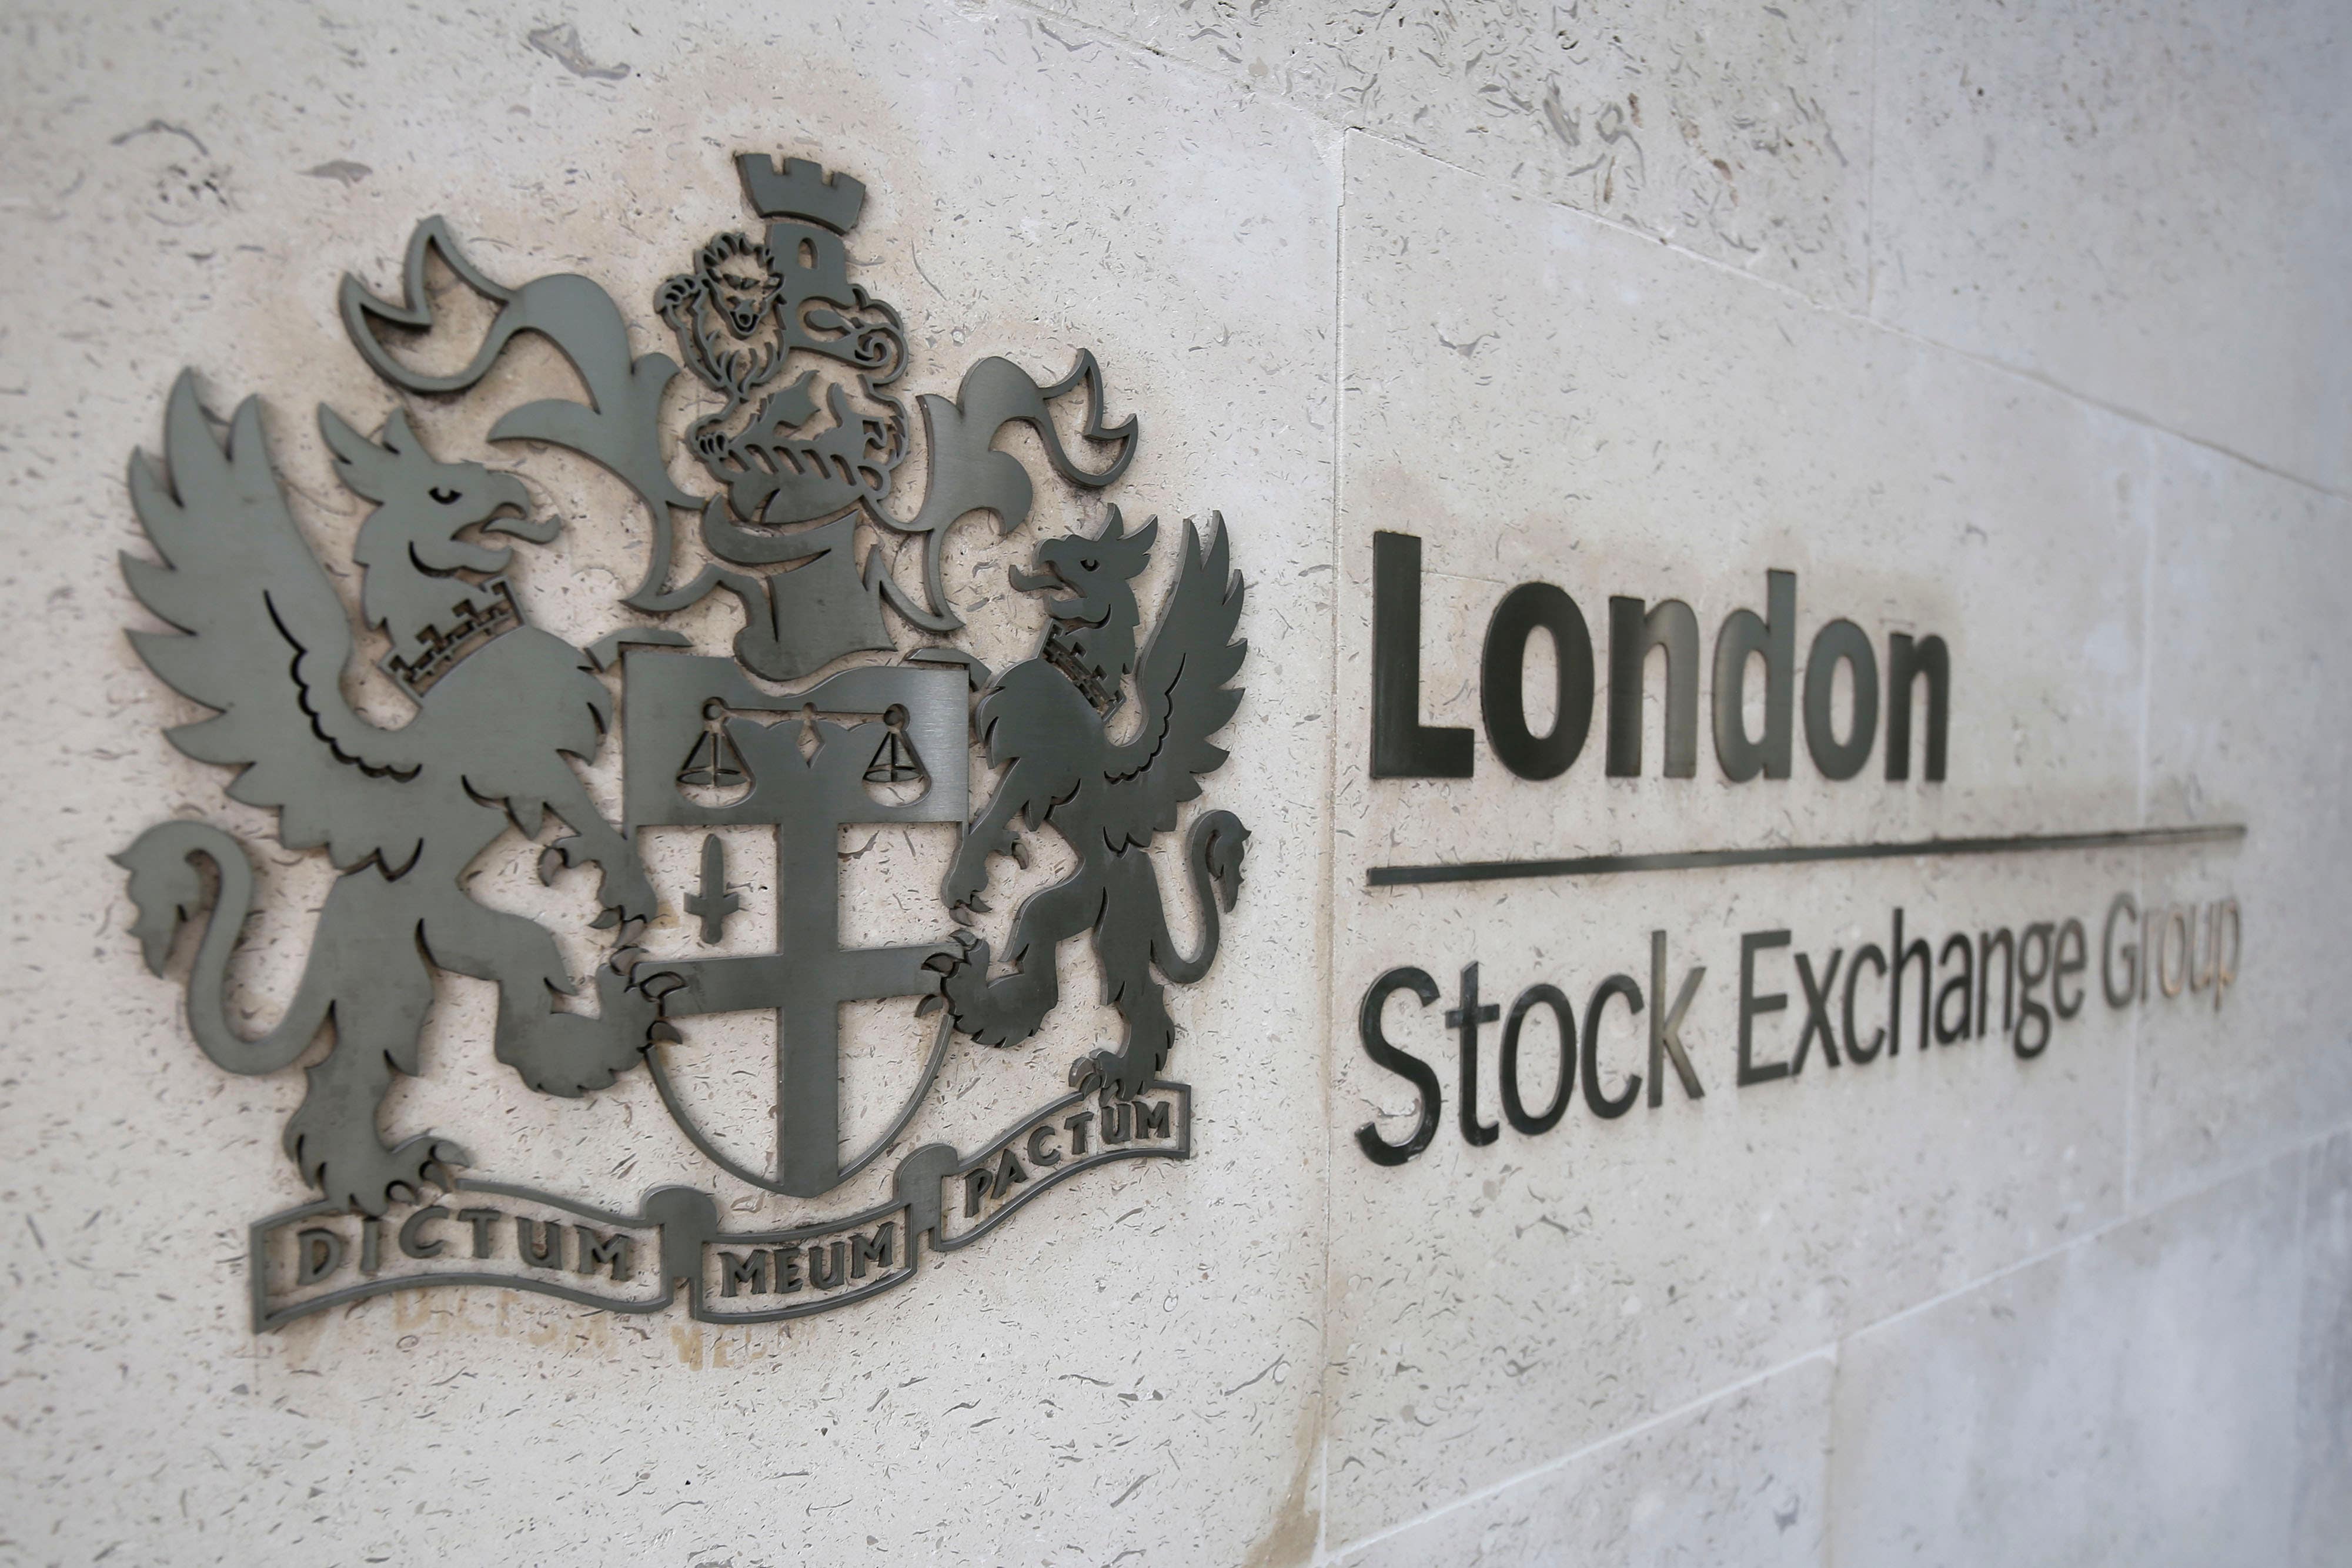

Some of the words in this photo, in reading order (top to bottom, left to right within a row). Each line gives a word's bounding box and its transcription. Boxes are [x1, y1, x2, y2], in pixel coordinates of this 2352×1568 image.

[1370, 531, 1949, 781] London
[1355, 931, 1704, 1166] Stock
[1738, 909, 2086, 1085] Exchange
[2103, 892, 2240, 1012] Group
[298, 1207, 634, 1284] DICTUM
[721, 1223, 893, 1296] MEUM
[964, 1101, 1170, 1217] PACTUM
